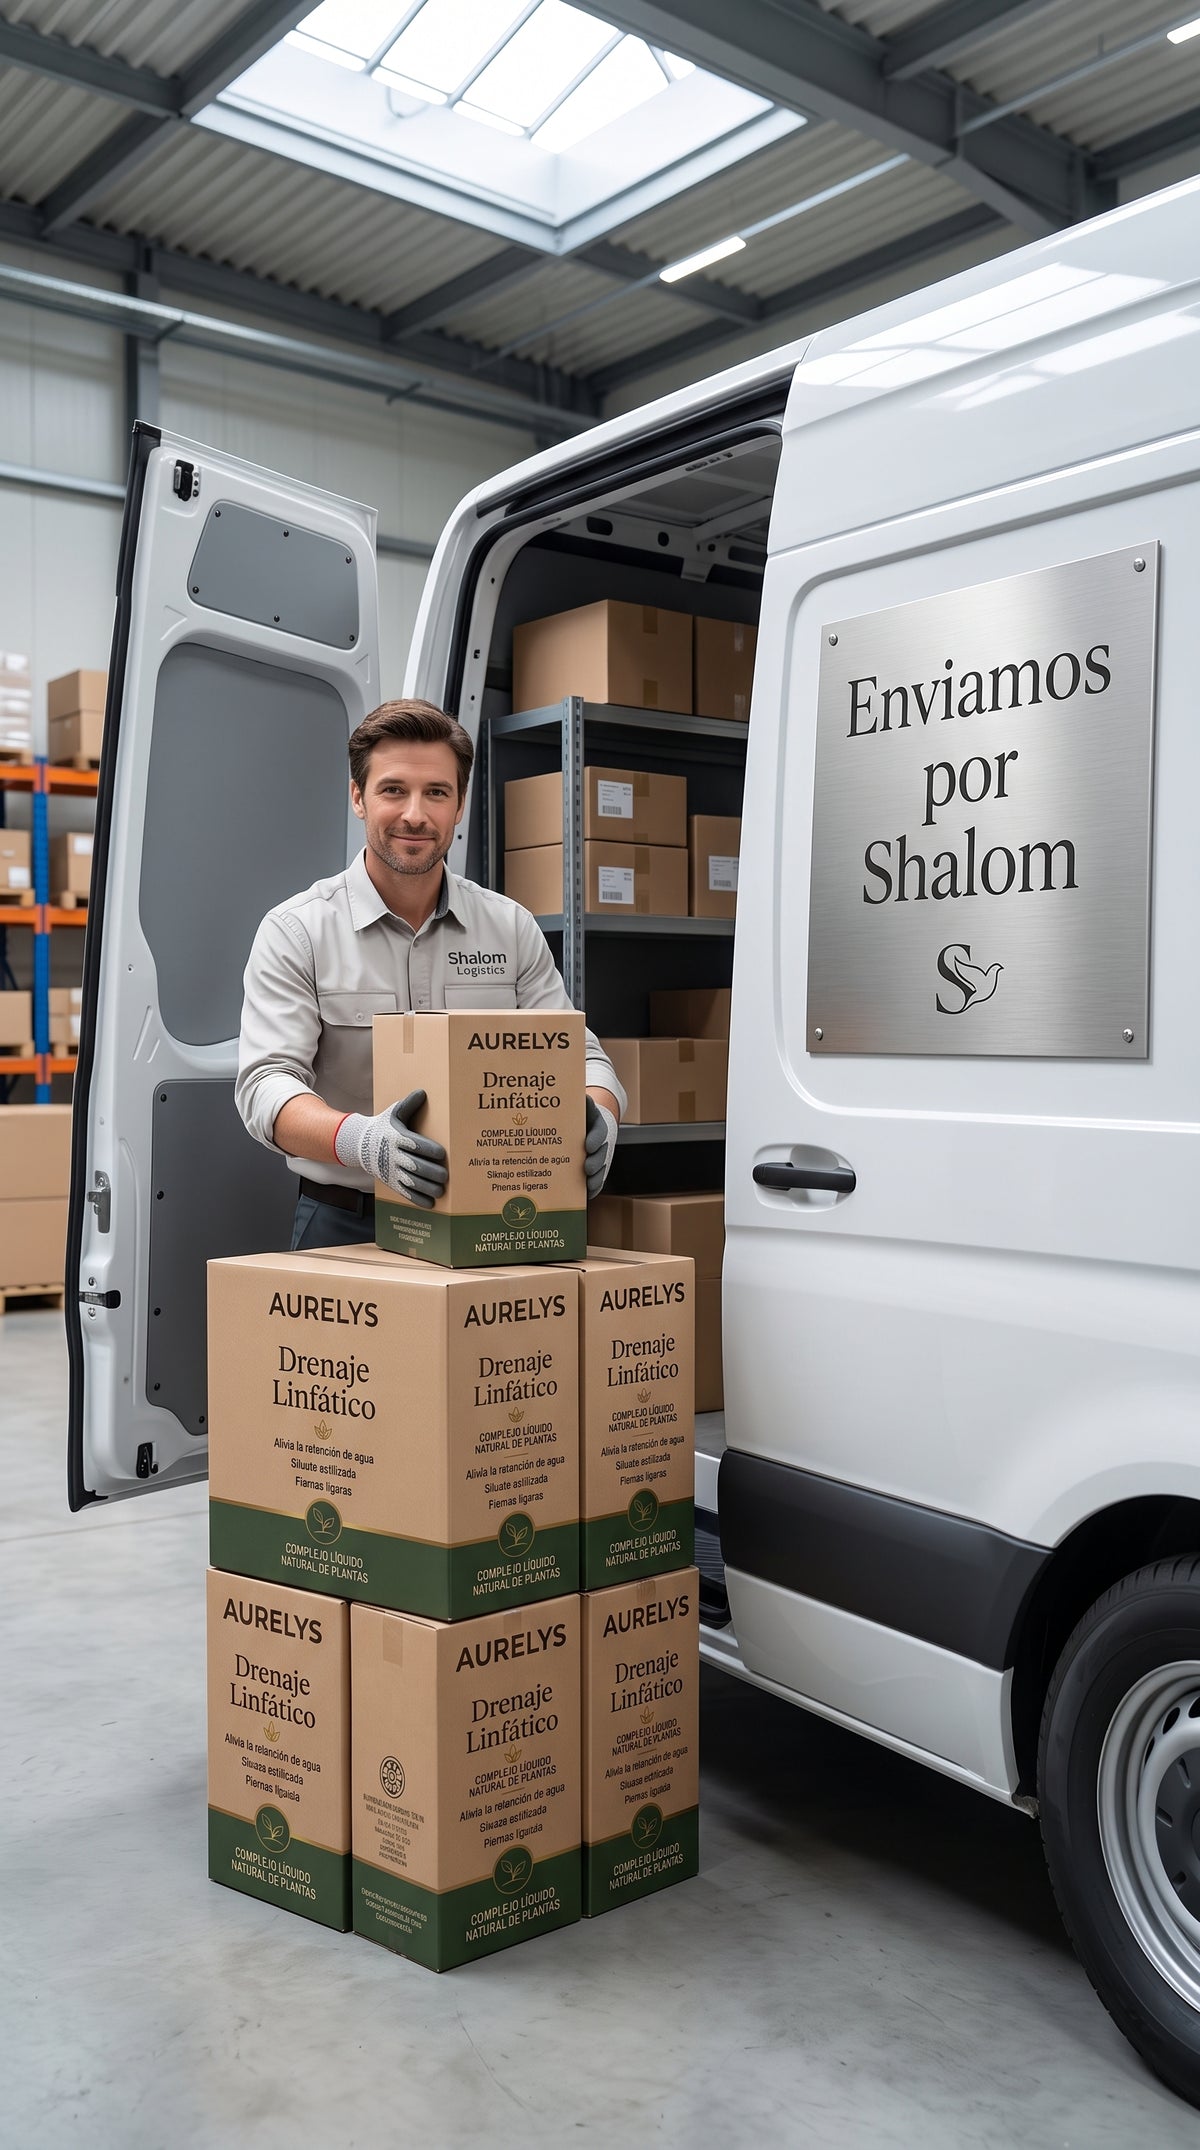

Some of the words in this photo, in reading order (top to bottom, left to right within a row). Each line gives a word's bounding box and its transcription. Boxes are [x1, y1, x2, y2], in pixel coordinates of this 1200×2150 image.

[846, 644, 1111, 738] Enviamos
[922, 750, 1018, 826] por
[863, 827, 1078, 905] Shalom
[448, 952, 507, 965] Shalom
[457, 965, 505, 977] Logistics
[468, 1032, 570, 1050] AURELYS
[483, 1072, 555, 1090] Drenaje
[478, 1092, 561, 1110] Linfático
[477, 1138, 512, 1147] NATURAL
[527, 1137, 562, 1145] PLANTAS
[481, 1129, 523, 1137] COMPLEJO
[526, 1127, 557, 1136] LÍQUIDO
[469, 1158, 490, 1166] Alivia
[502, 1157, 537, 1165] retención
[540, 1156, 548, 1164] de
[523, 1183, 548, 1191] ligeras
[516, 1241, 525, 1249] DE
[528, 1239, 565, 1249] PLANTAS
[269, 1292, 378, 1327] AURELYS
[600, 1282, 685, 1312] AURELYS
[464, 1295, 565, 1328] AURELYS
[611, 1334, 675, 1359] Drenaje
[278, 1345, 370, 1388] Drenaje
[479, 1350, 553, 1378] Drenaje
[607, 1360, 679, 1387] Linfático
[273, 1380, 376, 1420] Linfático
[474, 1379, 558, 1407] Linfático
[609, 1422, 638, 1432] NATURAL
[640, 1418, 648, 1427] DE
[650, 1413, 677, 1425] PLANTAS
[612, 1408, 647, 1421] COMPLEJO
[649, 1403, 674, 1415] LÍQUIDO
[475, 1441, 510, 1454] NATURAL
[512, 1439, 522, 1448] DE
[524, 1433, 557, 1446] PLANTAS
[480, 1427, 520, 1442] COMPLEJO
[523, 1423, 552, 1435] LÍQUIDO
[621, 1444, 627, 1453] la
[660, 1437, 668, 1446] de
[669, 1436, 684, 1446] agua
[274, 1438, 294, 1450] Alivia
[297, 1441, 303, 1452] la
[305, 1445, 340, 1458] retención
[343, 1449, 352, 1459] de
[355, 1453, 374, 1464] agua
[490, 1467, 496, 1476] la
[536, 1458, 545, 1467] de
[547, 1456, 565, 1467] agua
[606, 1554, 638, 1567] NATURAL
[640, 1549, 648, 1559] DE
[650, 1541, 680, 1557] PLANTAS
[610, 1536, 646, 1554] COMPLEJO
[649, 1529, 676, 1545] LÍQUIDO
[281, 1555, 317, 1572] NATURAL
[319, 1563, 329, 1575] DE
[332, 1566, 368, 1583] PLANTAS
[286, 1543, 328, 1561] COMPLEJO
[331, 1551, 363, 1568] LÍQUIDO
[524, 1555, 555, 1571] LÍQUIDO
[473, 1582, 510, 1595] NATURAL
[512, 1576, 523, 1586] DE
[525, 1567, 560, 1584] PLANTAS
[223, 1599, 322, 1644] AURELYS
[603, 1595, 689, 1638] AURELYS
[456, 1623, 566, 1672] AURELYS
[235, 1654, 310, 1696] Drenaje
[615, 1650, 679, 1684] Drenaje
[230, 1683, 315, 1728] Linfático
[471, 1684, 553, 1723] Drenaje
[610, 1676, 683, 1713] Linfático
[466, 1712, 559, 1754] Linfático
[612, 1742, 642, 1756] NATURAL
[644, 1737, 652, 1747] DE
[247, 1740, 253, 1751] la
[291, 1755, 300, 1766] de
[302, 1760, 321, 1772] agua
[625, 1764, 630, 1772] la
[663, 1752, 671, 1760] de
[469, 1780, 506, 1798] NATURAL
[508, 1775, 519, 1786] DE
[521, 1765, 556, 1783] PLANTAS
[485, 1805, 492, 1814] la
[534, 1790, 543, 1799] de
[546, 1784, 565, 1797] agua
[652, 1843, 680, 1862] LÍQUIDO
[232, 1859, 267, 1881] NATURAL
[269, 1873, 279, 1886] DE
[281, 1878, 316, 1900] PLANTAS
[279, 1861, 310, 1884] LÍQUIDO
[610, 1872, 641, 1891] NATURAL
[643, 1866, 652, 1877] DE
[653, 1854, 684, 1873] PLANTAS
[521, 1887, 555, 1909] LÍQUIDO
[465, 1920, 507, 1942] NATURAL
[509, 1915, 520, 1926] DE
[522, 1899, 560, 1922] PLANTAS
